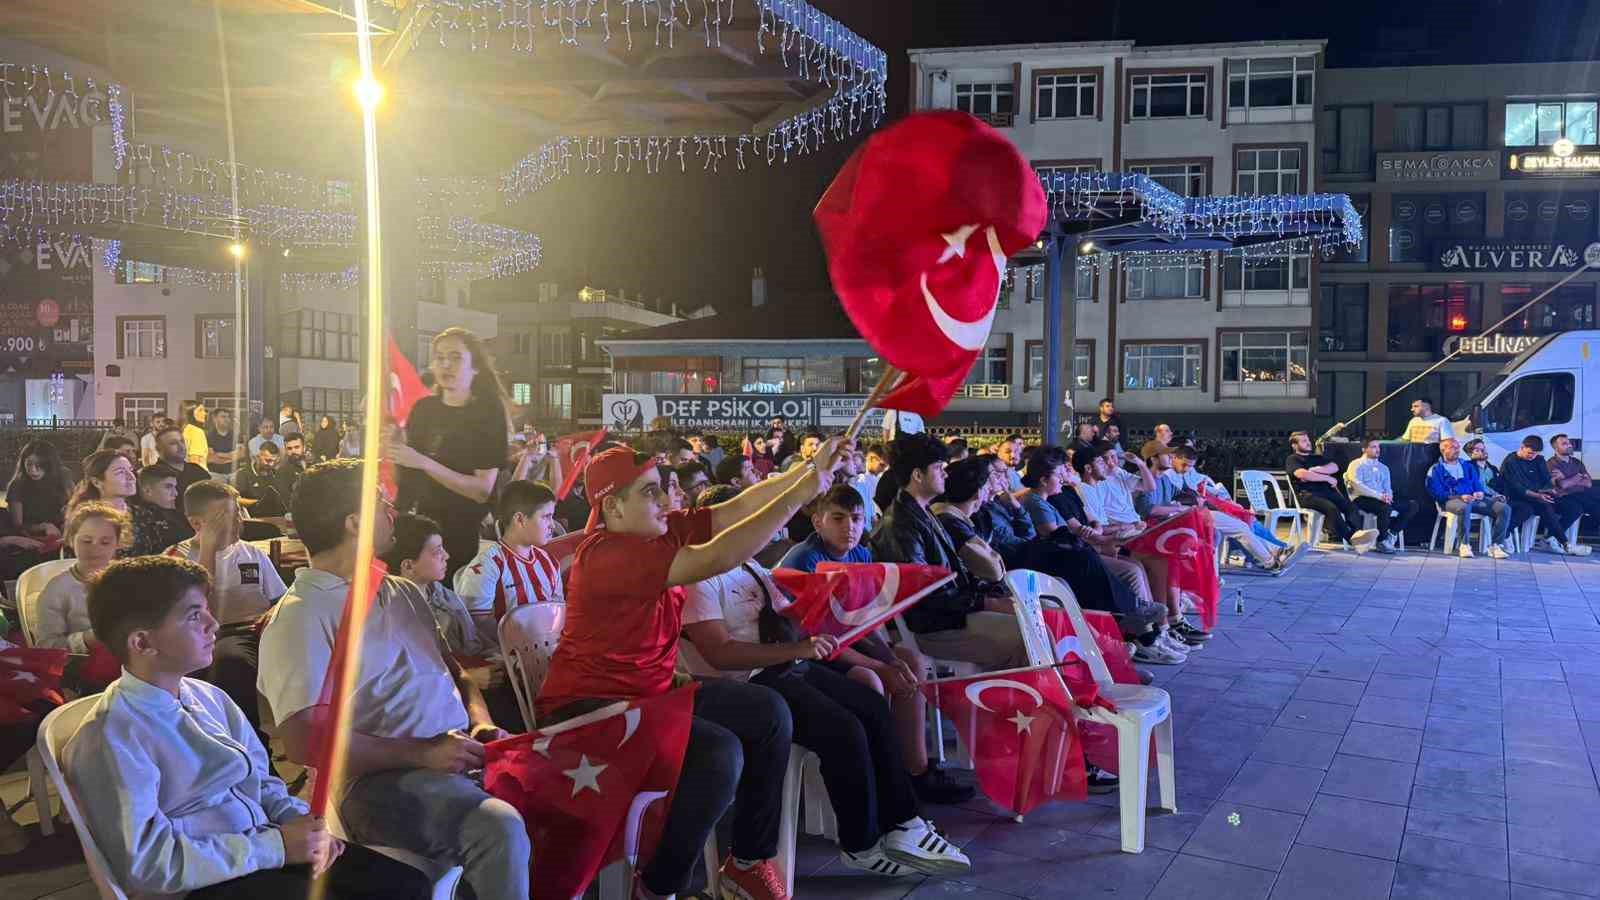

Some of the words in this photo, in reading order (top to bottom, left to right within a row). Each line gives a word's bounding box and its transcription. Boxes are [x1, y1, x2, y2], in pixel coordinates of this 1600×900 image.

[1382, 159, 1428, 169] SEMA
[1447, 245, 1571, 268] ALVERA
[662, 400, 700, 416] DEF
[707, 398, 811, 416] PSİKOLOJİ
